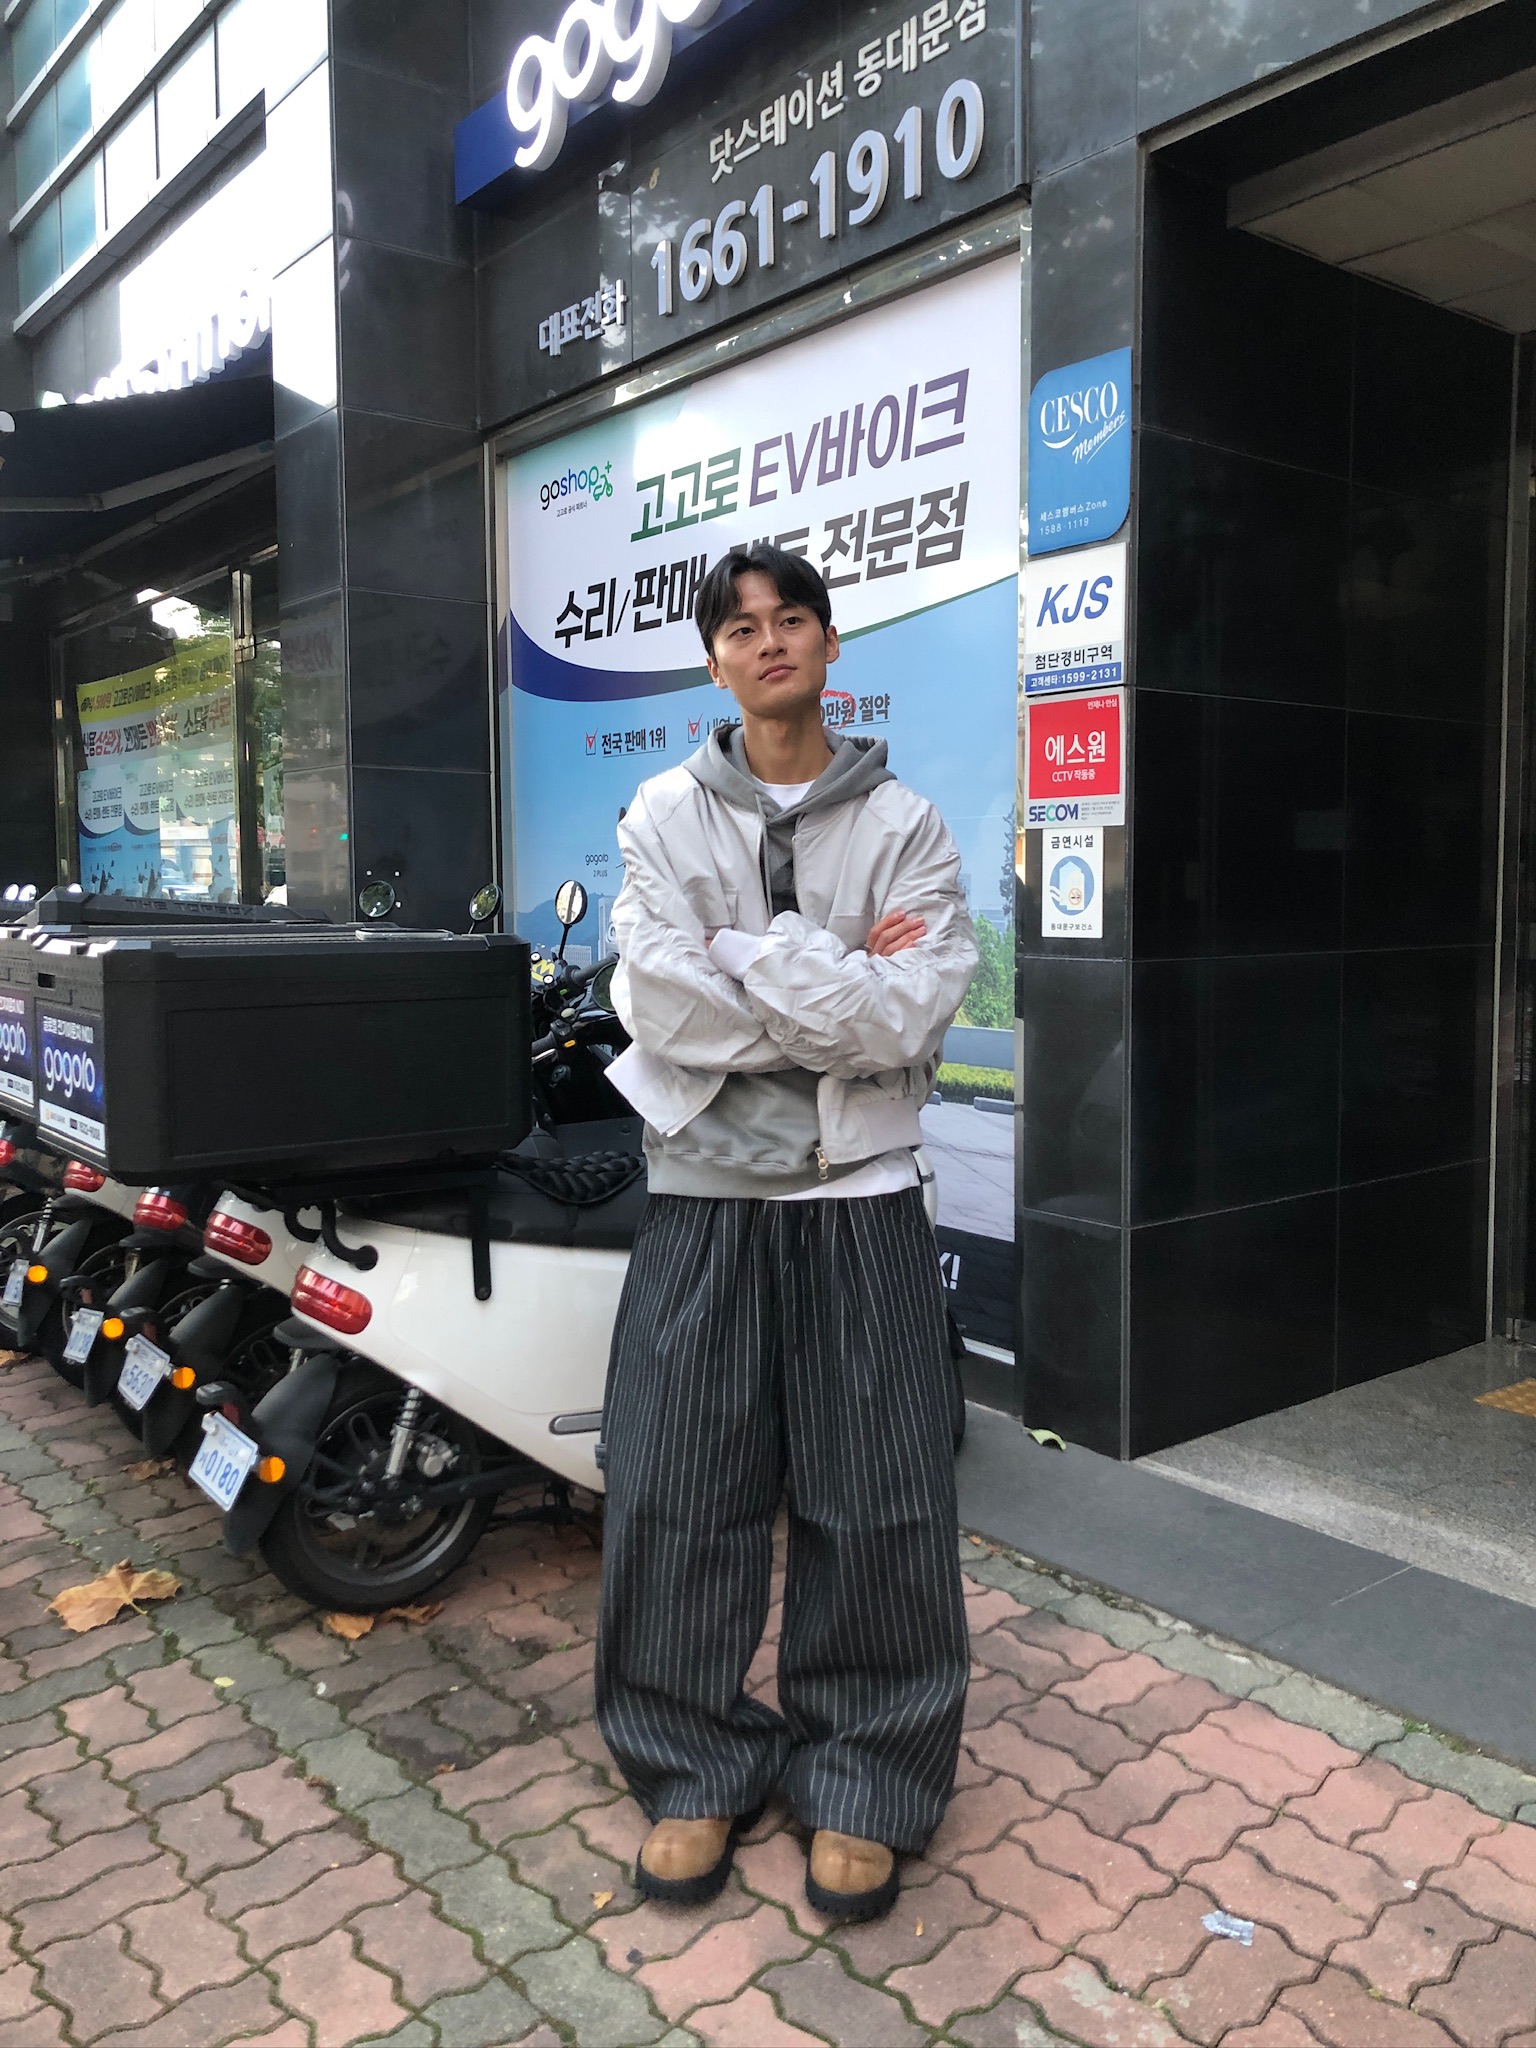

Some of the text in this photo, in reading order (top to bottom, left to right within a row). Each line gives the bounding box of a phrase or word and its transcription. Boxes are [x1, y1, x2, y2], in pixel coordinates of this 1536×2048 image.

[507, 0, 722, 169] gog
[709, 60, 844, 184] 닷스테이션
[538, 79, 985, 356] 대표전화 1661-1910
[1040, 381, 1118, 436] CESCO
[630, 367, 970, 543] 고고로 EV바이크
[1072, 410, 1126, 464] Members
[1085, 500, 1107, 511] Zone
[820, 480, 970, 590] 전문점
[1036, 575, 1113, 628] KJS
[1035, 644, 1113, 671] 첨단경비구역
[859, 693, 891, 722] 절약
[601, 726, 666, 755] 전국 판매 1위
[1044, 730, 1106, 766] 에스원
[1052, 768, 1096, 783] CCTV 작동중
[1028, 803, 1079, 822] SECOM
[1051, 834, 1094, 850] 금연시설
